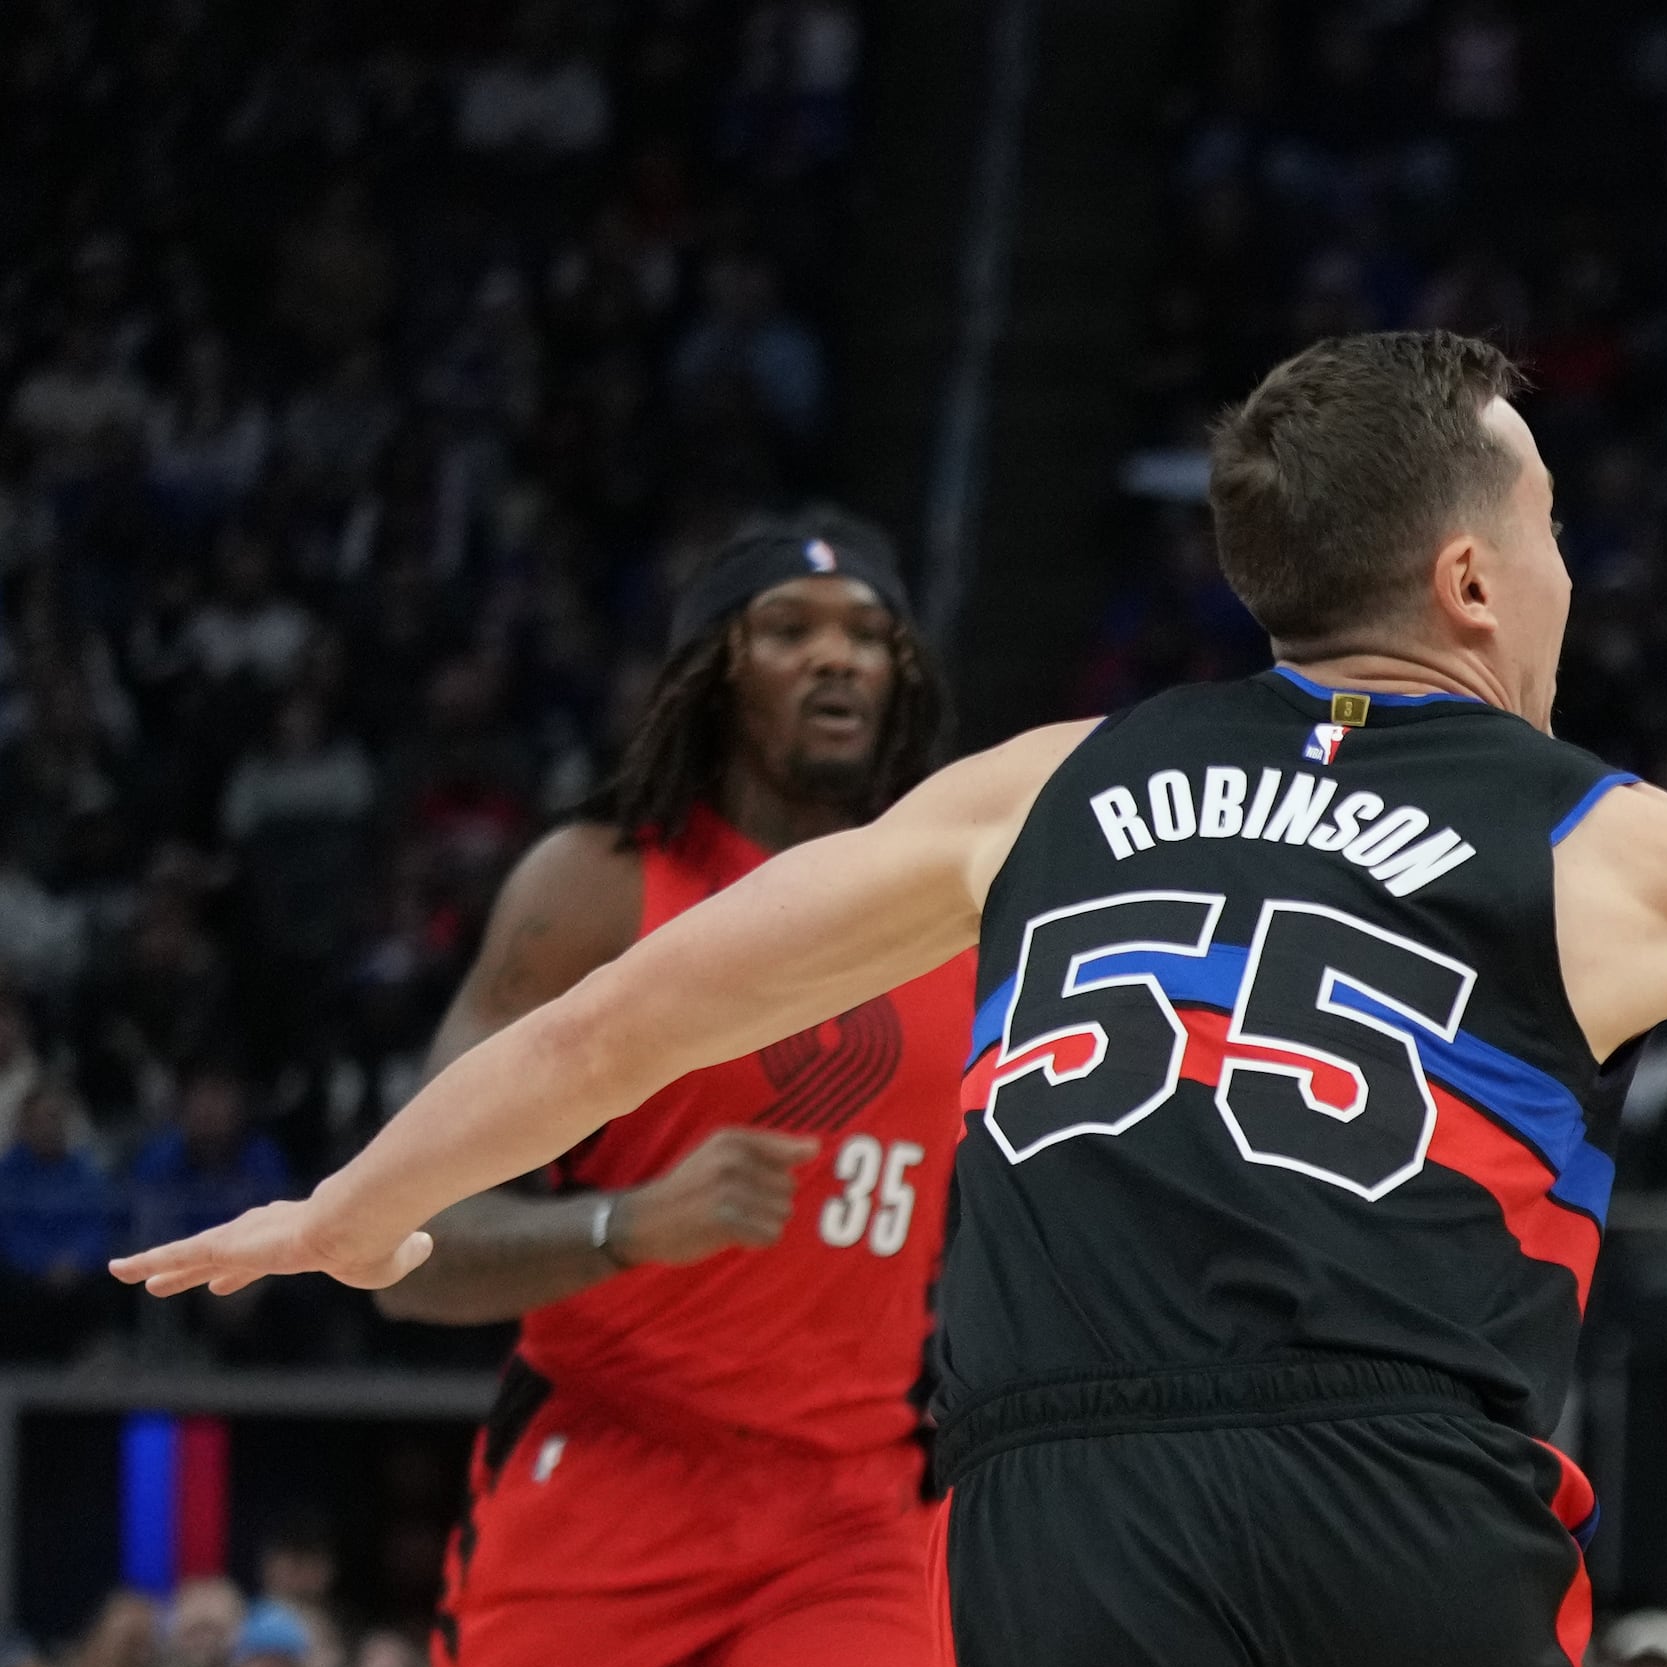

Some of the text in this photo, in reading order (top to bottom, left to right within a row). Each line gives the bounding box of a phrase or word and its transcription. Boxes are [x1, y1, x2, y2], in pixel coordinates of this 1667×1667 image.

[1090, 766, 1476, 897] ROBINSON
[984, 891, 1477, 1202] 55
[819, 1134, 925, 1258] 35
